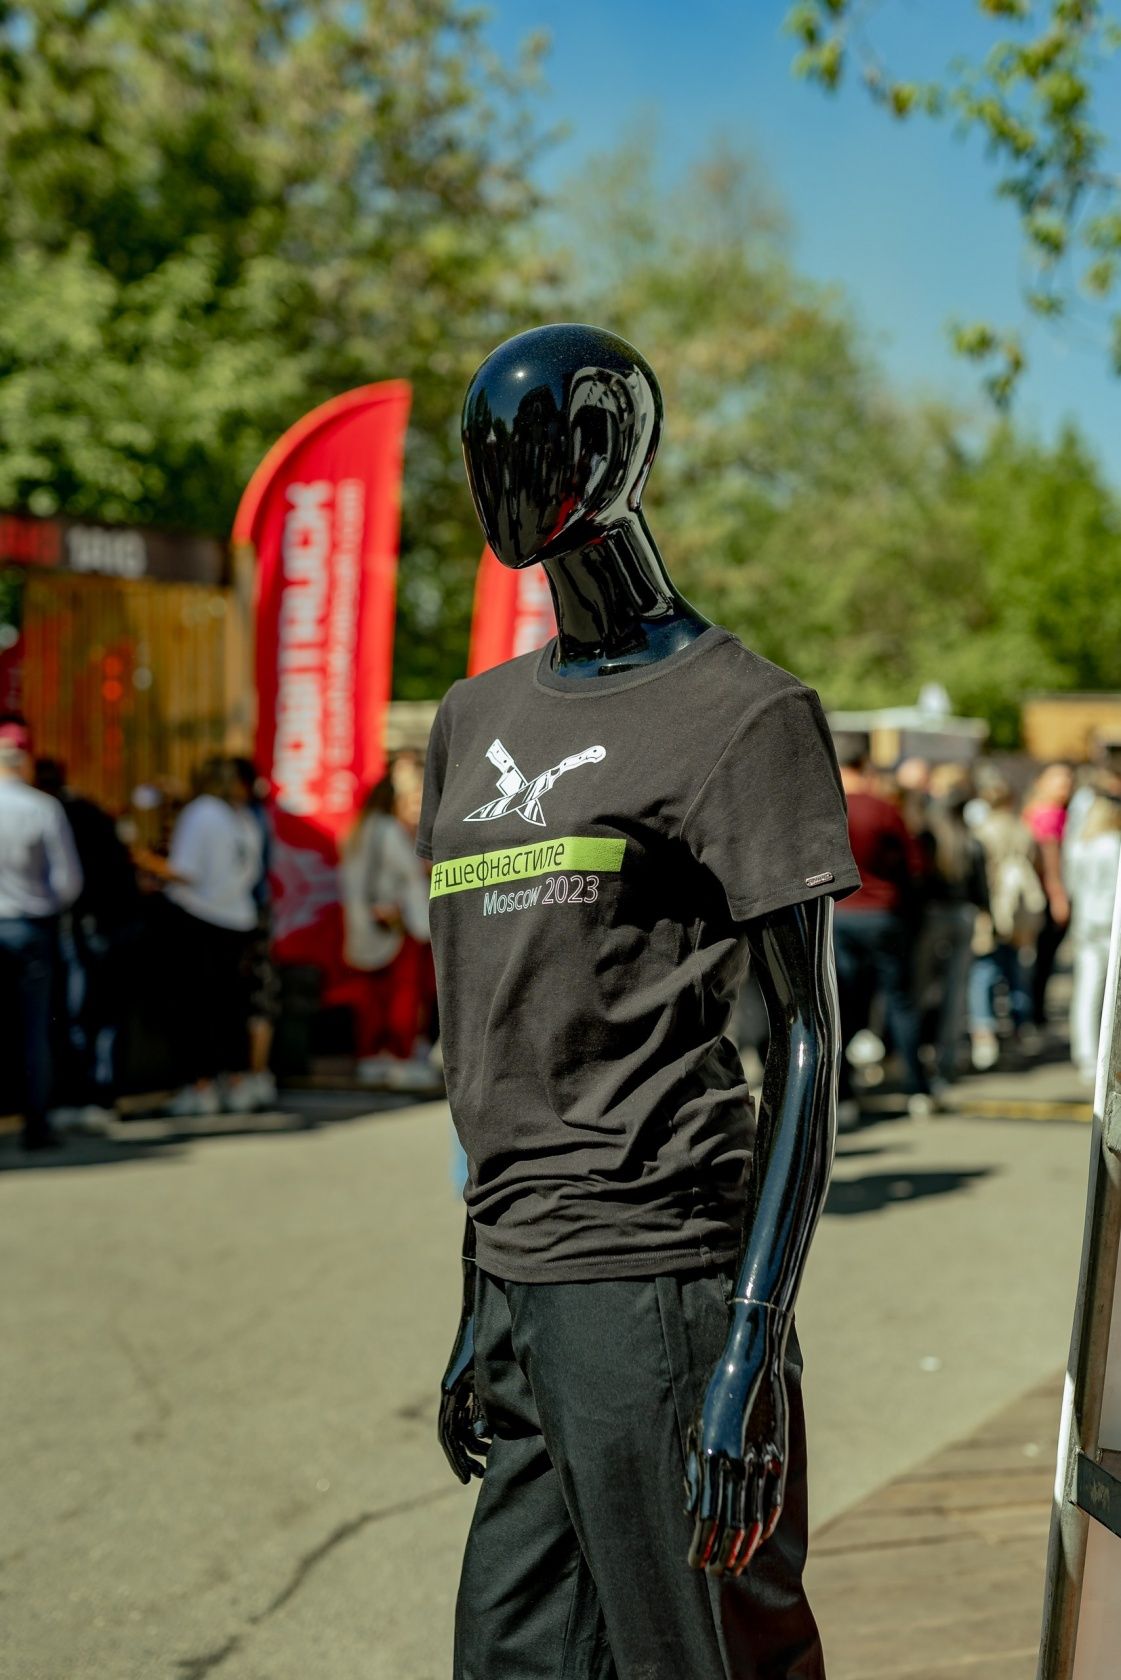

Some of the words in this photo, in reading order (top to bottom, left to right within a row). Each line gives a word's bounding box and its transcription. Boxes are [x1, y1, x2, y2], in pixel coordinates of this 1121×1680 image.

[434, 843, 565, 890] #шефнастиле
[483, 885, 542, 916] Moscow
[542, 875, 600, 904] 2023
